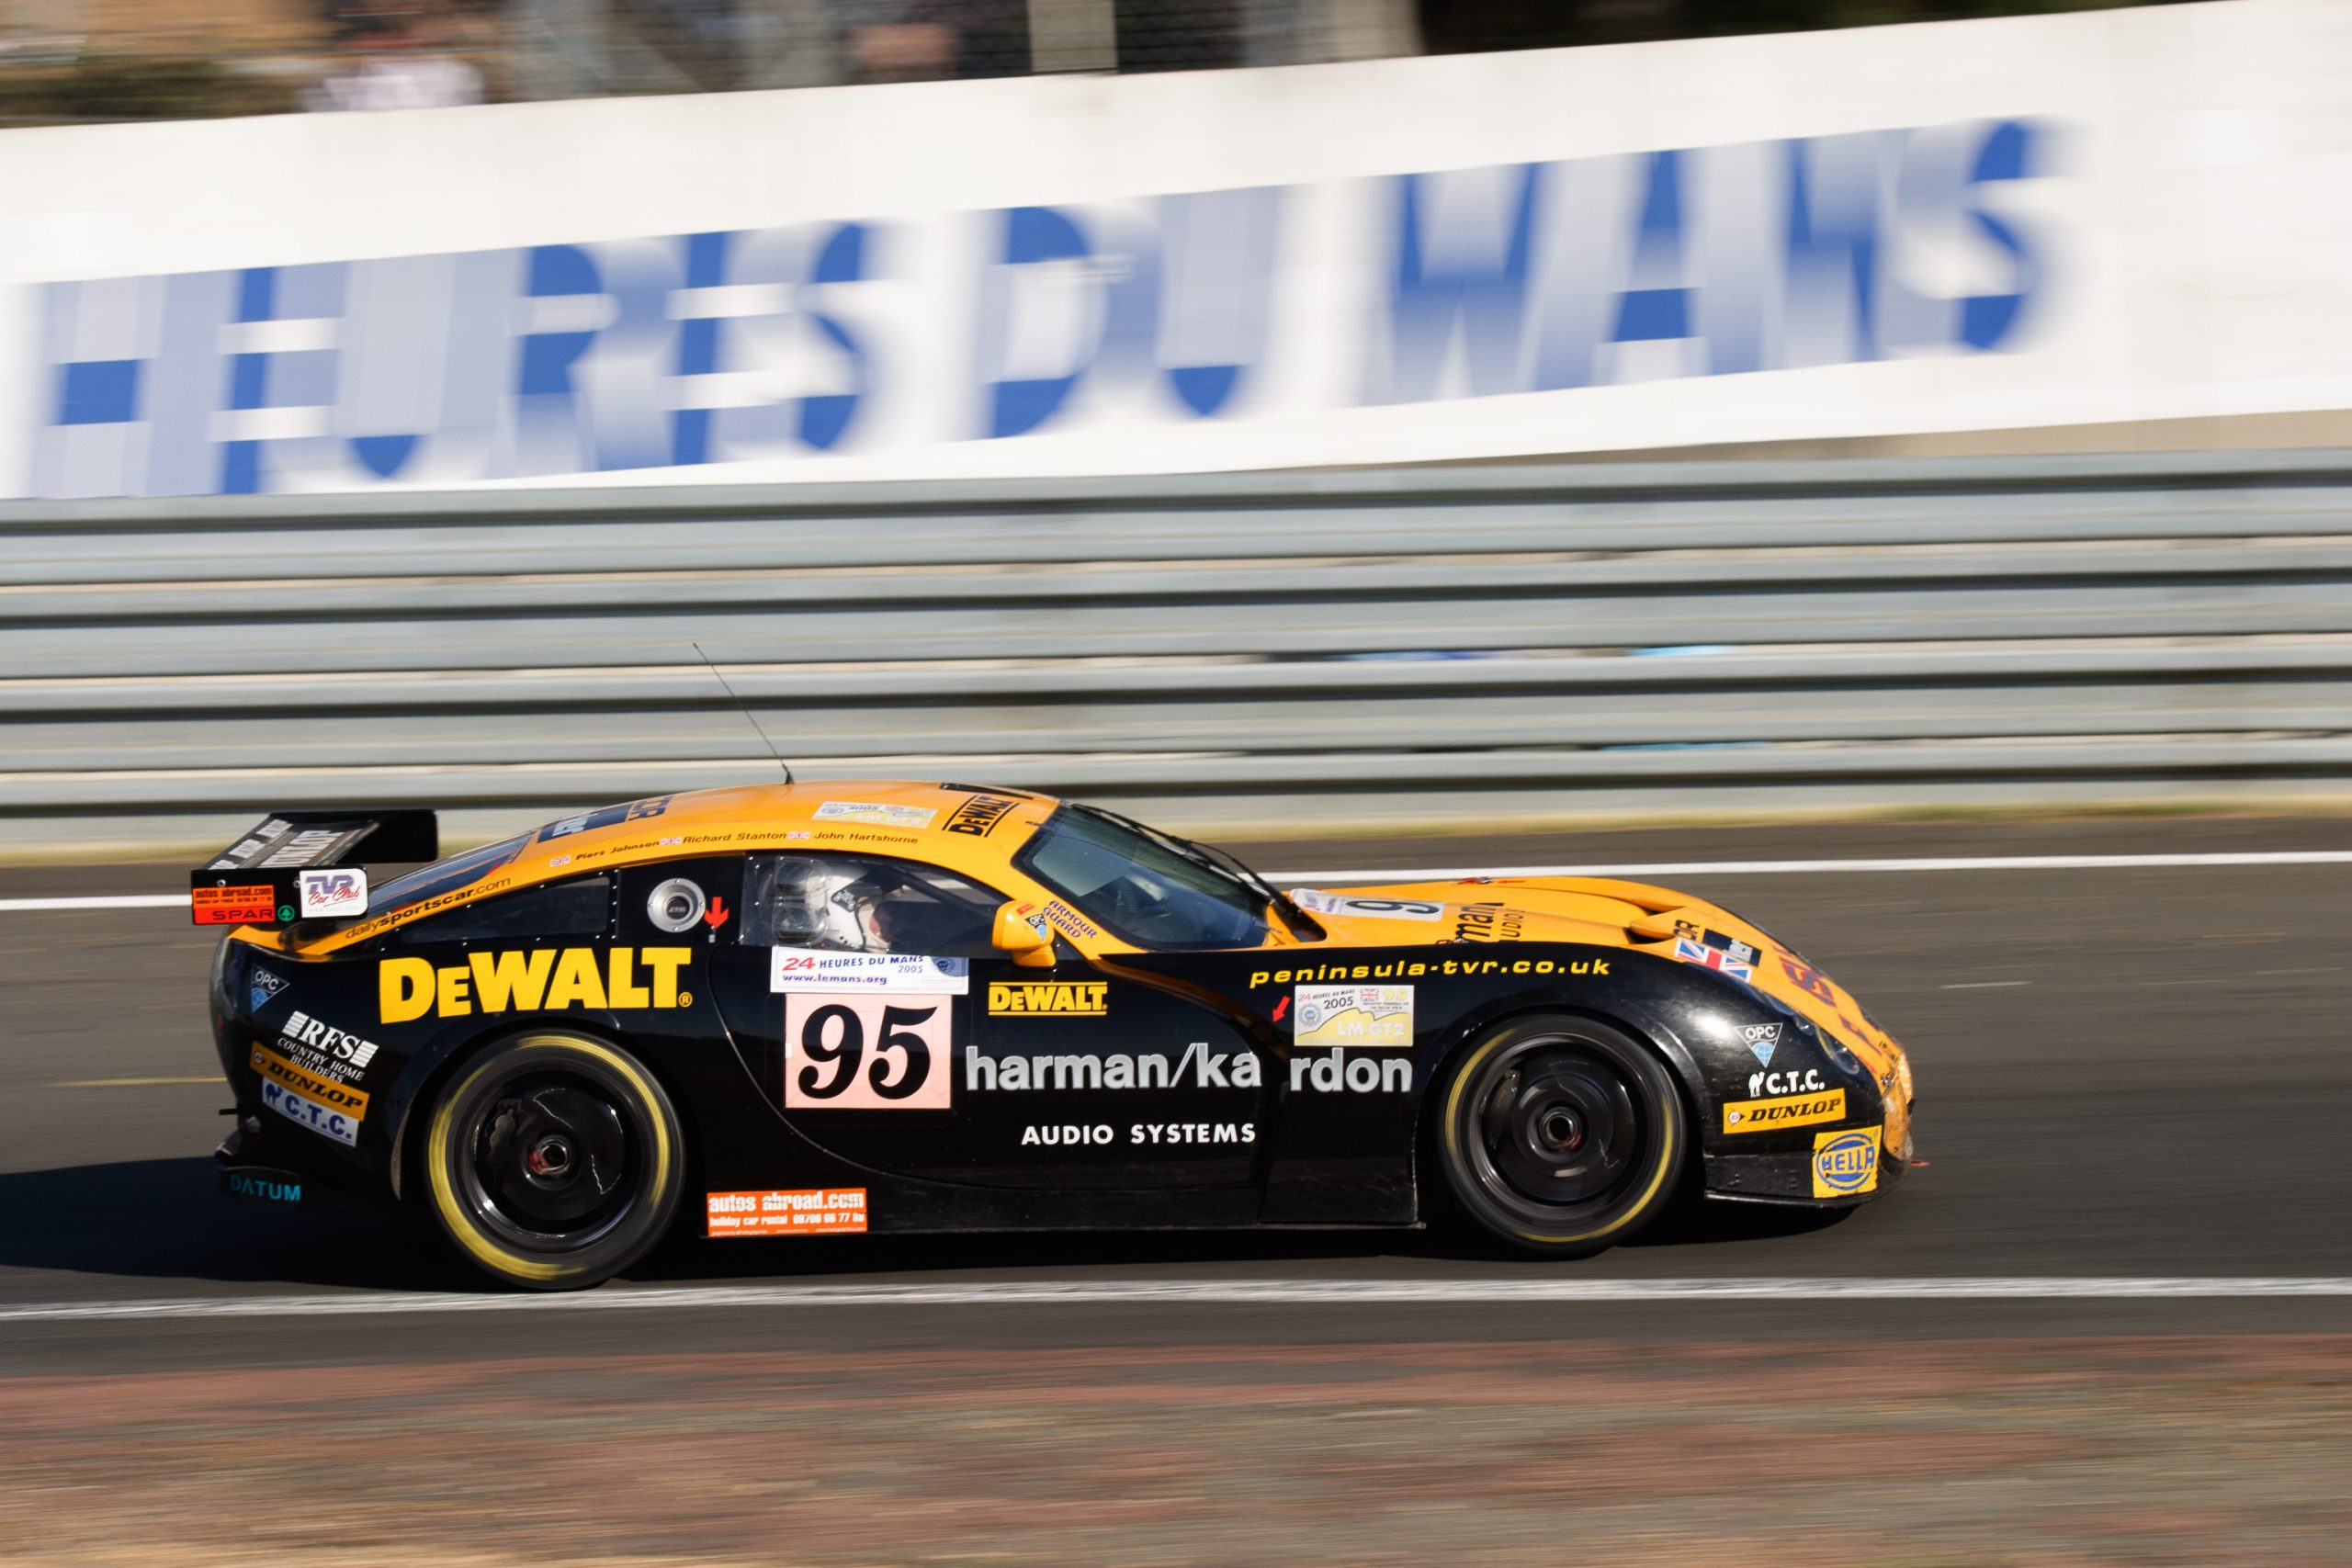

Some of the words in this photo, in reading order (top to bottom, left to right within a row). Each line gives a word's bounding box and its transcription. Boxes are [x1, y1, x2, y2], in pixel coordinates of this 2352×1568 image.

[576, 850, 605, 861] Piers
[610, 840, 660, 853] Johnson
[683, 833, 732, 844] Richard
[736, 832, 786, 840] Stanton
[814, 831, 844, 840] John
[850, 832, 919, 844] Hartshorne
[305, 874, 354, 895] TVR
[212, 908, 274, 920] SPAR
[345, 876, 511, 940] dailysportscar.com
[1049, 900, 1097, 939] ARMOUR
[1044, 907, 1081, 938] GUARD
[782, 956, 816, 971] 24
[820, 957, 863, 968] HEURES
[868, 957, 885, 965] DU
[889, 955, 923, 964] MANS
[898, 964, 923, 974] 2005
[1250, 958, 1611, 989] peninsula-tvr.co.uk
[254, 970, 279, 991] OPC
[783, 973, 888, 986] www.lemans.org
[1298, 992, 1311, 1002] 24
[1323, 996, 1354, 1010] 2005
[1383, 987, 1408, 1001] 95
[298, 1018, 361, 1059] RFS
[1745, 1026, 1776, 1041] OPC
[277, 1037, 328, 1066] COUNTRY
[330, 1060, 366, 1081] HOME
[797, 1003, 938, 1100] 95
[289, 1054, 345, 1084] BUILDERS
[266, 1061, 364, 1108] DUNLOP
[1766, 1069, 1826, 1095] C.T.C.
[285, 1094, 353, 1139] C.T.C.
[1748, 1098, 1842, 1122] DUNLOP
[1021, 1125, 1114, 1145] AUDIO
[1130, 1123, 1256, 1144] SYSTEMS
[1821, 1145, 1876, 1171] HELLA
[231, 1174, 301, 1201] DATUM
[709, 1194, 757, 1213] autos
[762, 1190, 865, 1211] abroad.com
[709, 1215, 741, 1227] holiday
[742, 1215, 759, 1225] car
[761, 1214, 788, 1225] rental
[839, 1213, 851, 1223] 77
